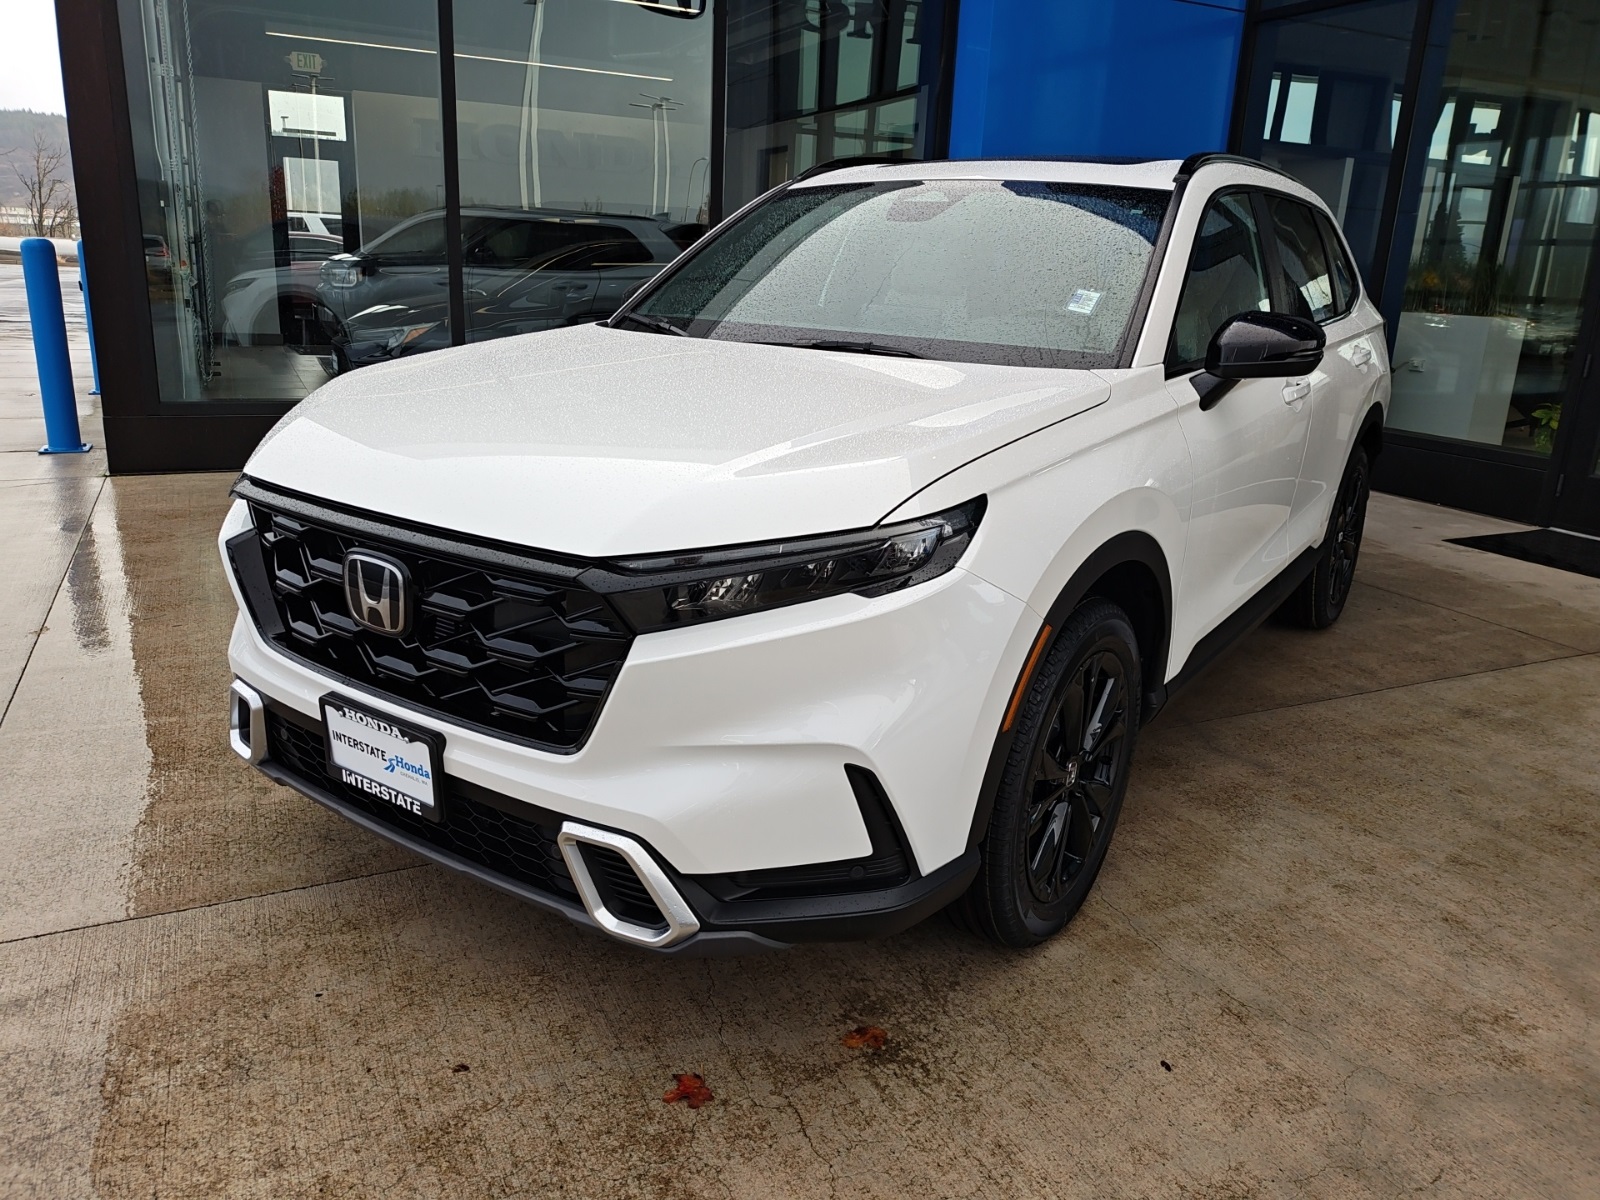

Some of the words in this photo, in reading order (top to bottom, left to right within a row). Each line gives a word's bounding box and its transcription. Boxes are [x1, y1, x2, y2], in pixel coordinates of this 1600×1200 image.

[297, 53, 317, 70] EXIT
[412, 117, 680, 177] HOND
[342, 707, 404, 740] HONDA
[332, 729, 388, 762] INTERSTATE
[394, 755, 431, 780] Honda
[341, 769, 422, 816] INTERSTATE
